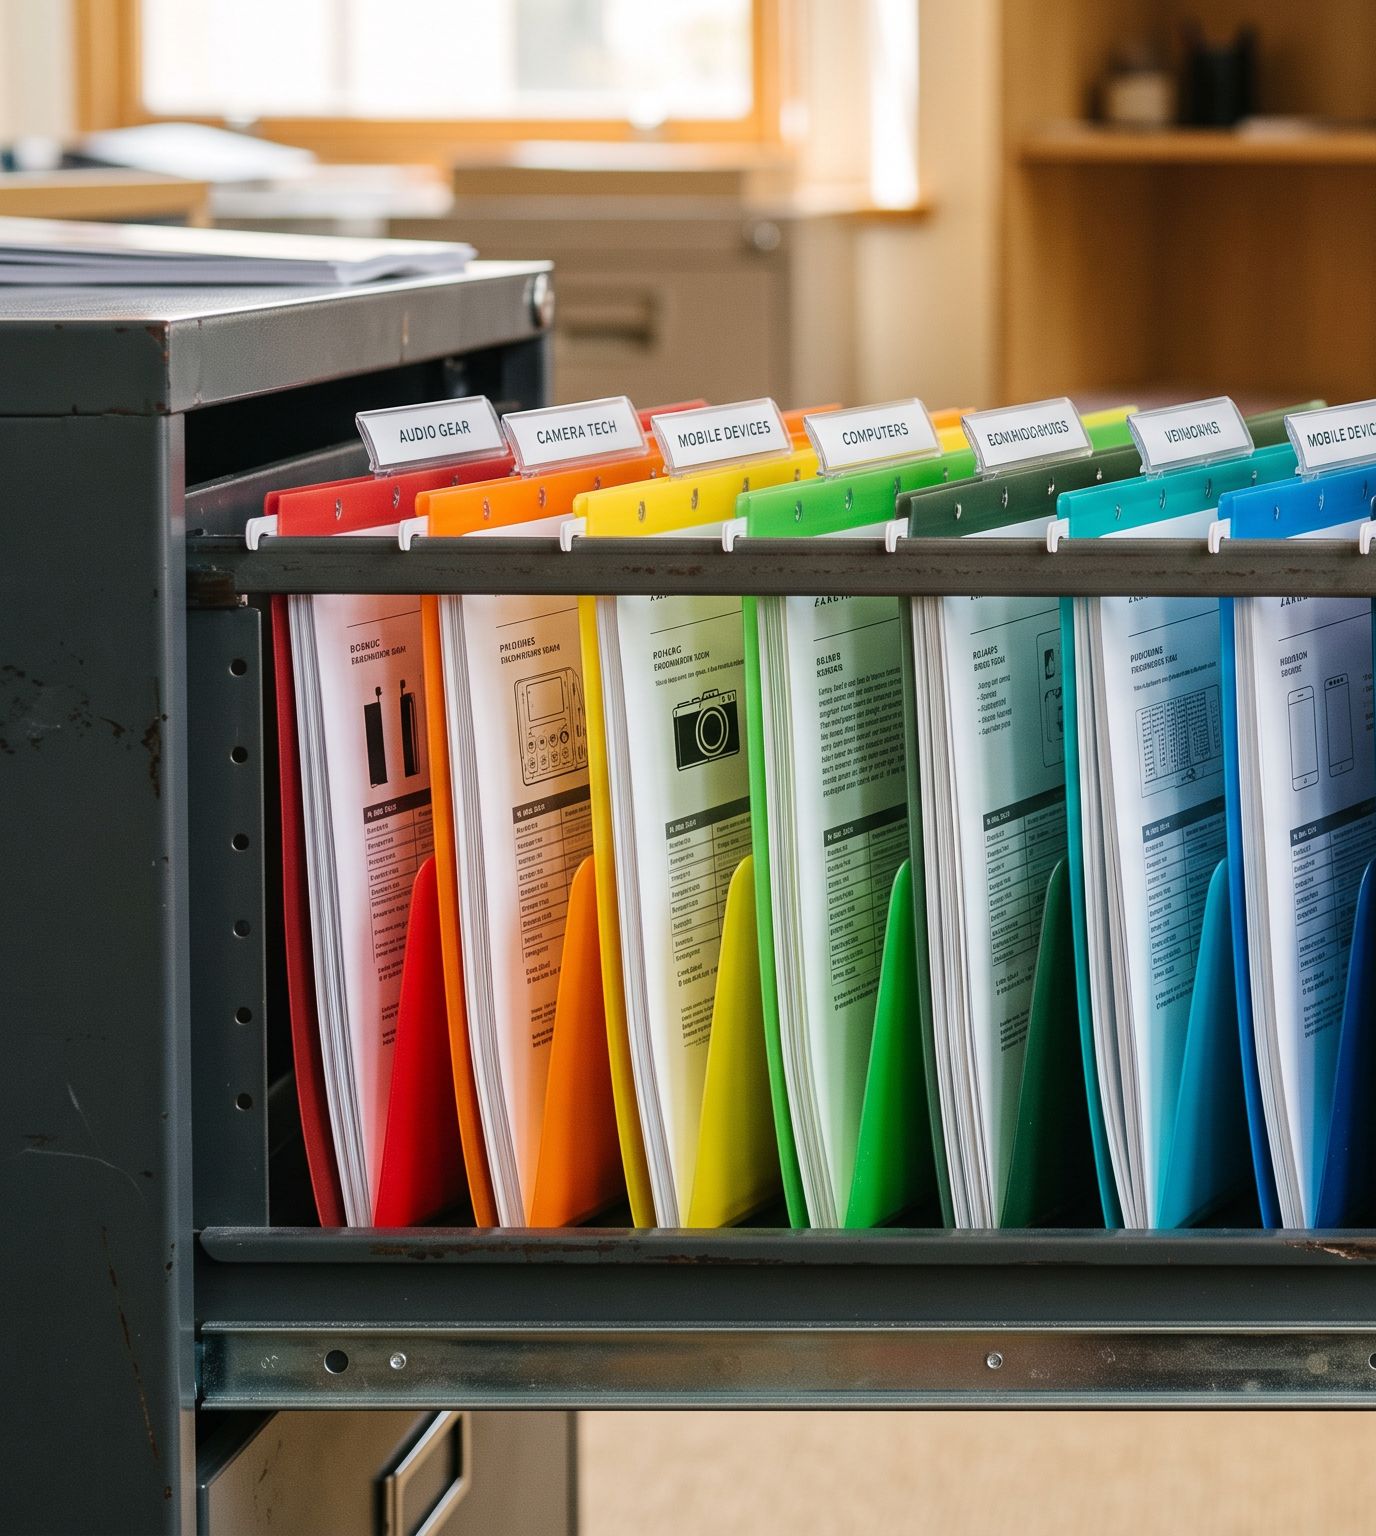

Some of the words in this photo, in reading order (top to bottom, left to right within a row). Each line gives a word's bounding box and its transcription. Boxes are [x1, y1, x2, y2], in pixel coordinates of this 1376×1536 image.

[399, 425, 436, 444] AUDIO
[438, 420, 471, 437] GEAR
[536, 425, 586, 445] CAMERA
[586, 420, 617, 437] TECH
[677, 428, 723, 448] MOBILE
[842, 422, 909, 446] COMPUTERS
[1307, 428, 1347, 447] MOBILE
